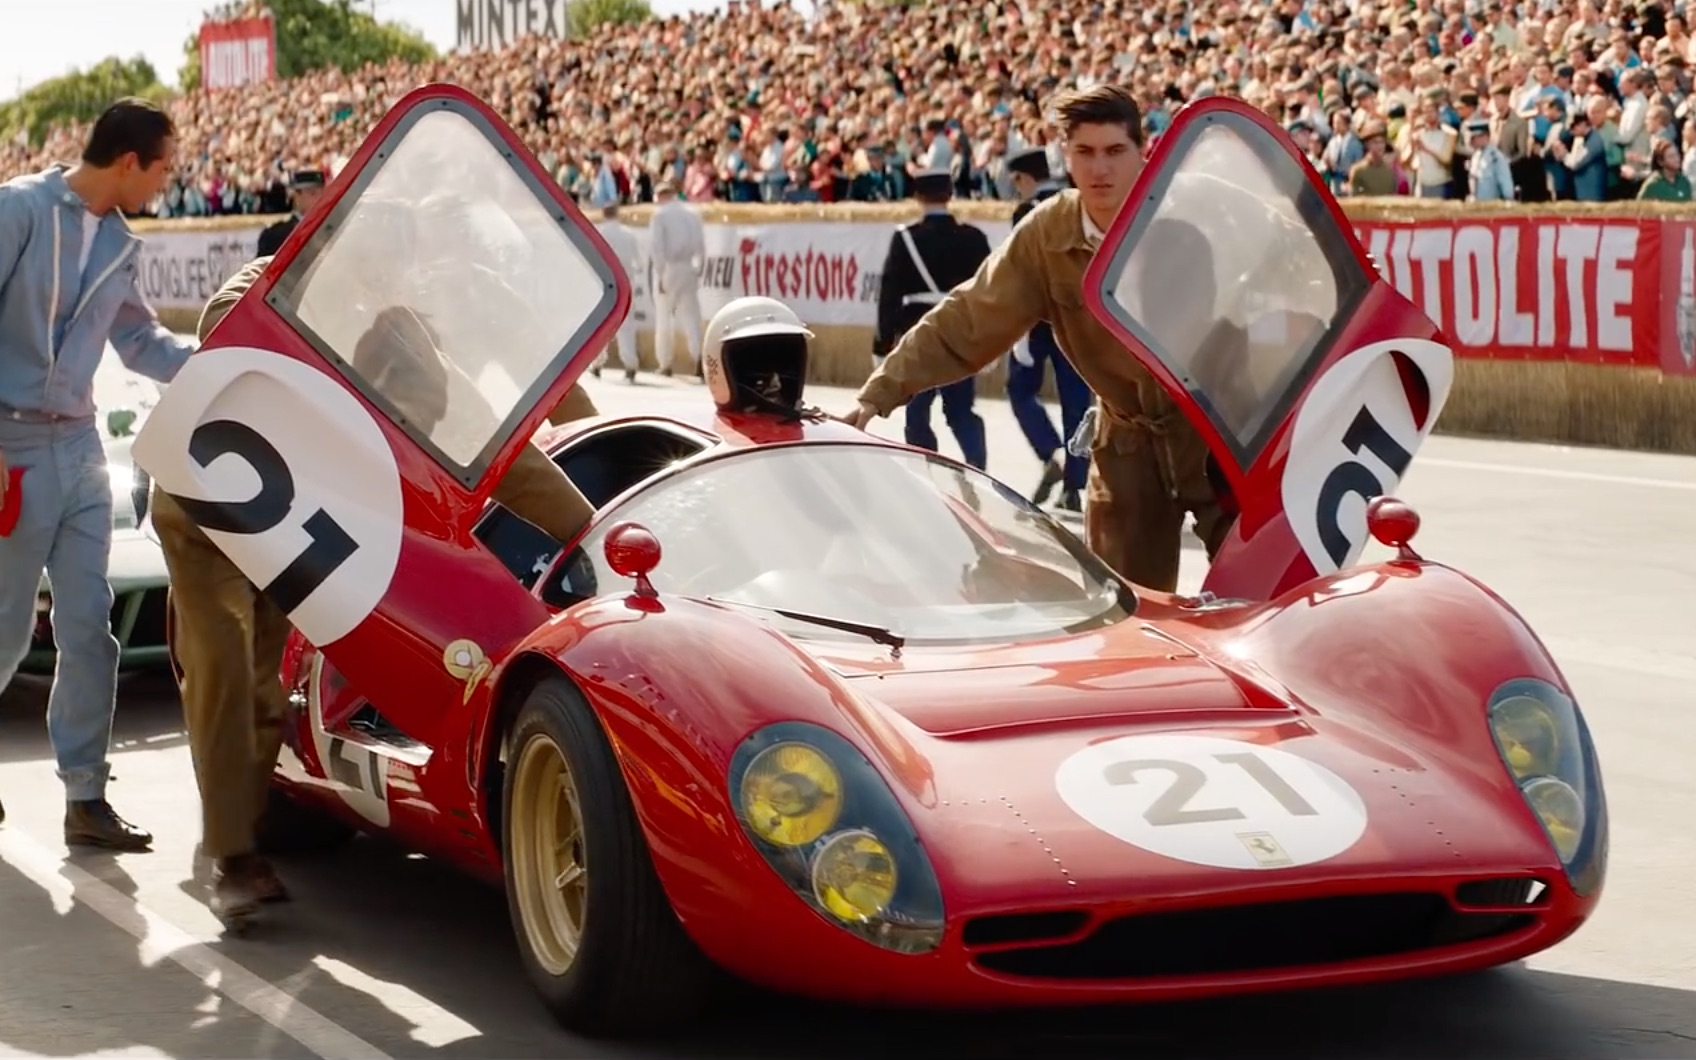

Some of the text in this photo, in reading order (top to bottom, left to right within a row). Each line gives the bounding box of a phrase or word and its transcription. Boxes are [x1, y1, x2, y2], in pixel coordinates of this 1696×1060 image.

[457, 0, 560, 48] MINTEX
[739, 236, 858, 302] Firestone
[1354, 222, 1640, 351] UTOLITE
[166, 419, 361, 617] 21
[1103, 752, 1320, 827] 21
